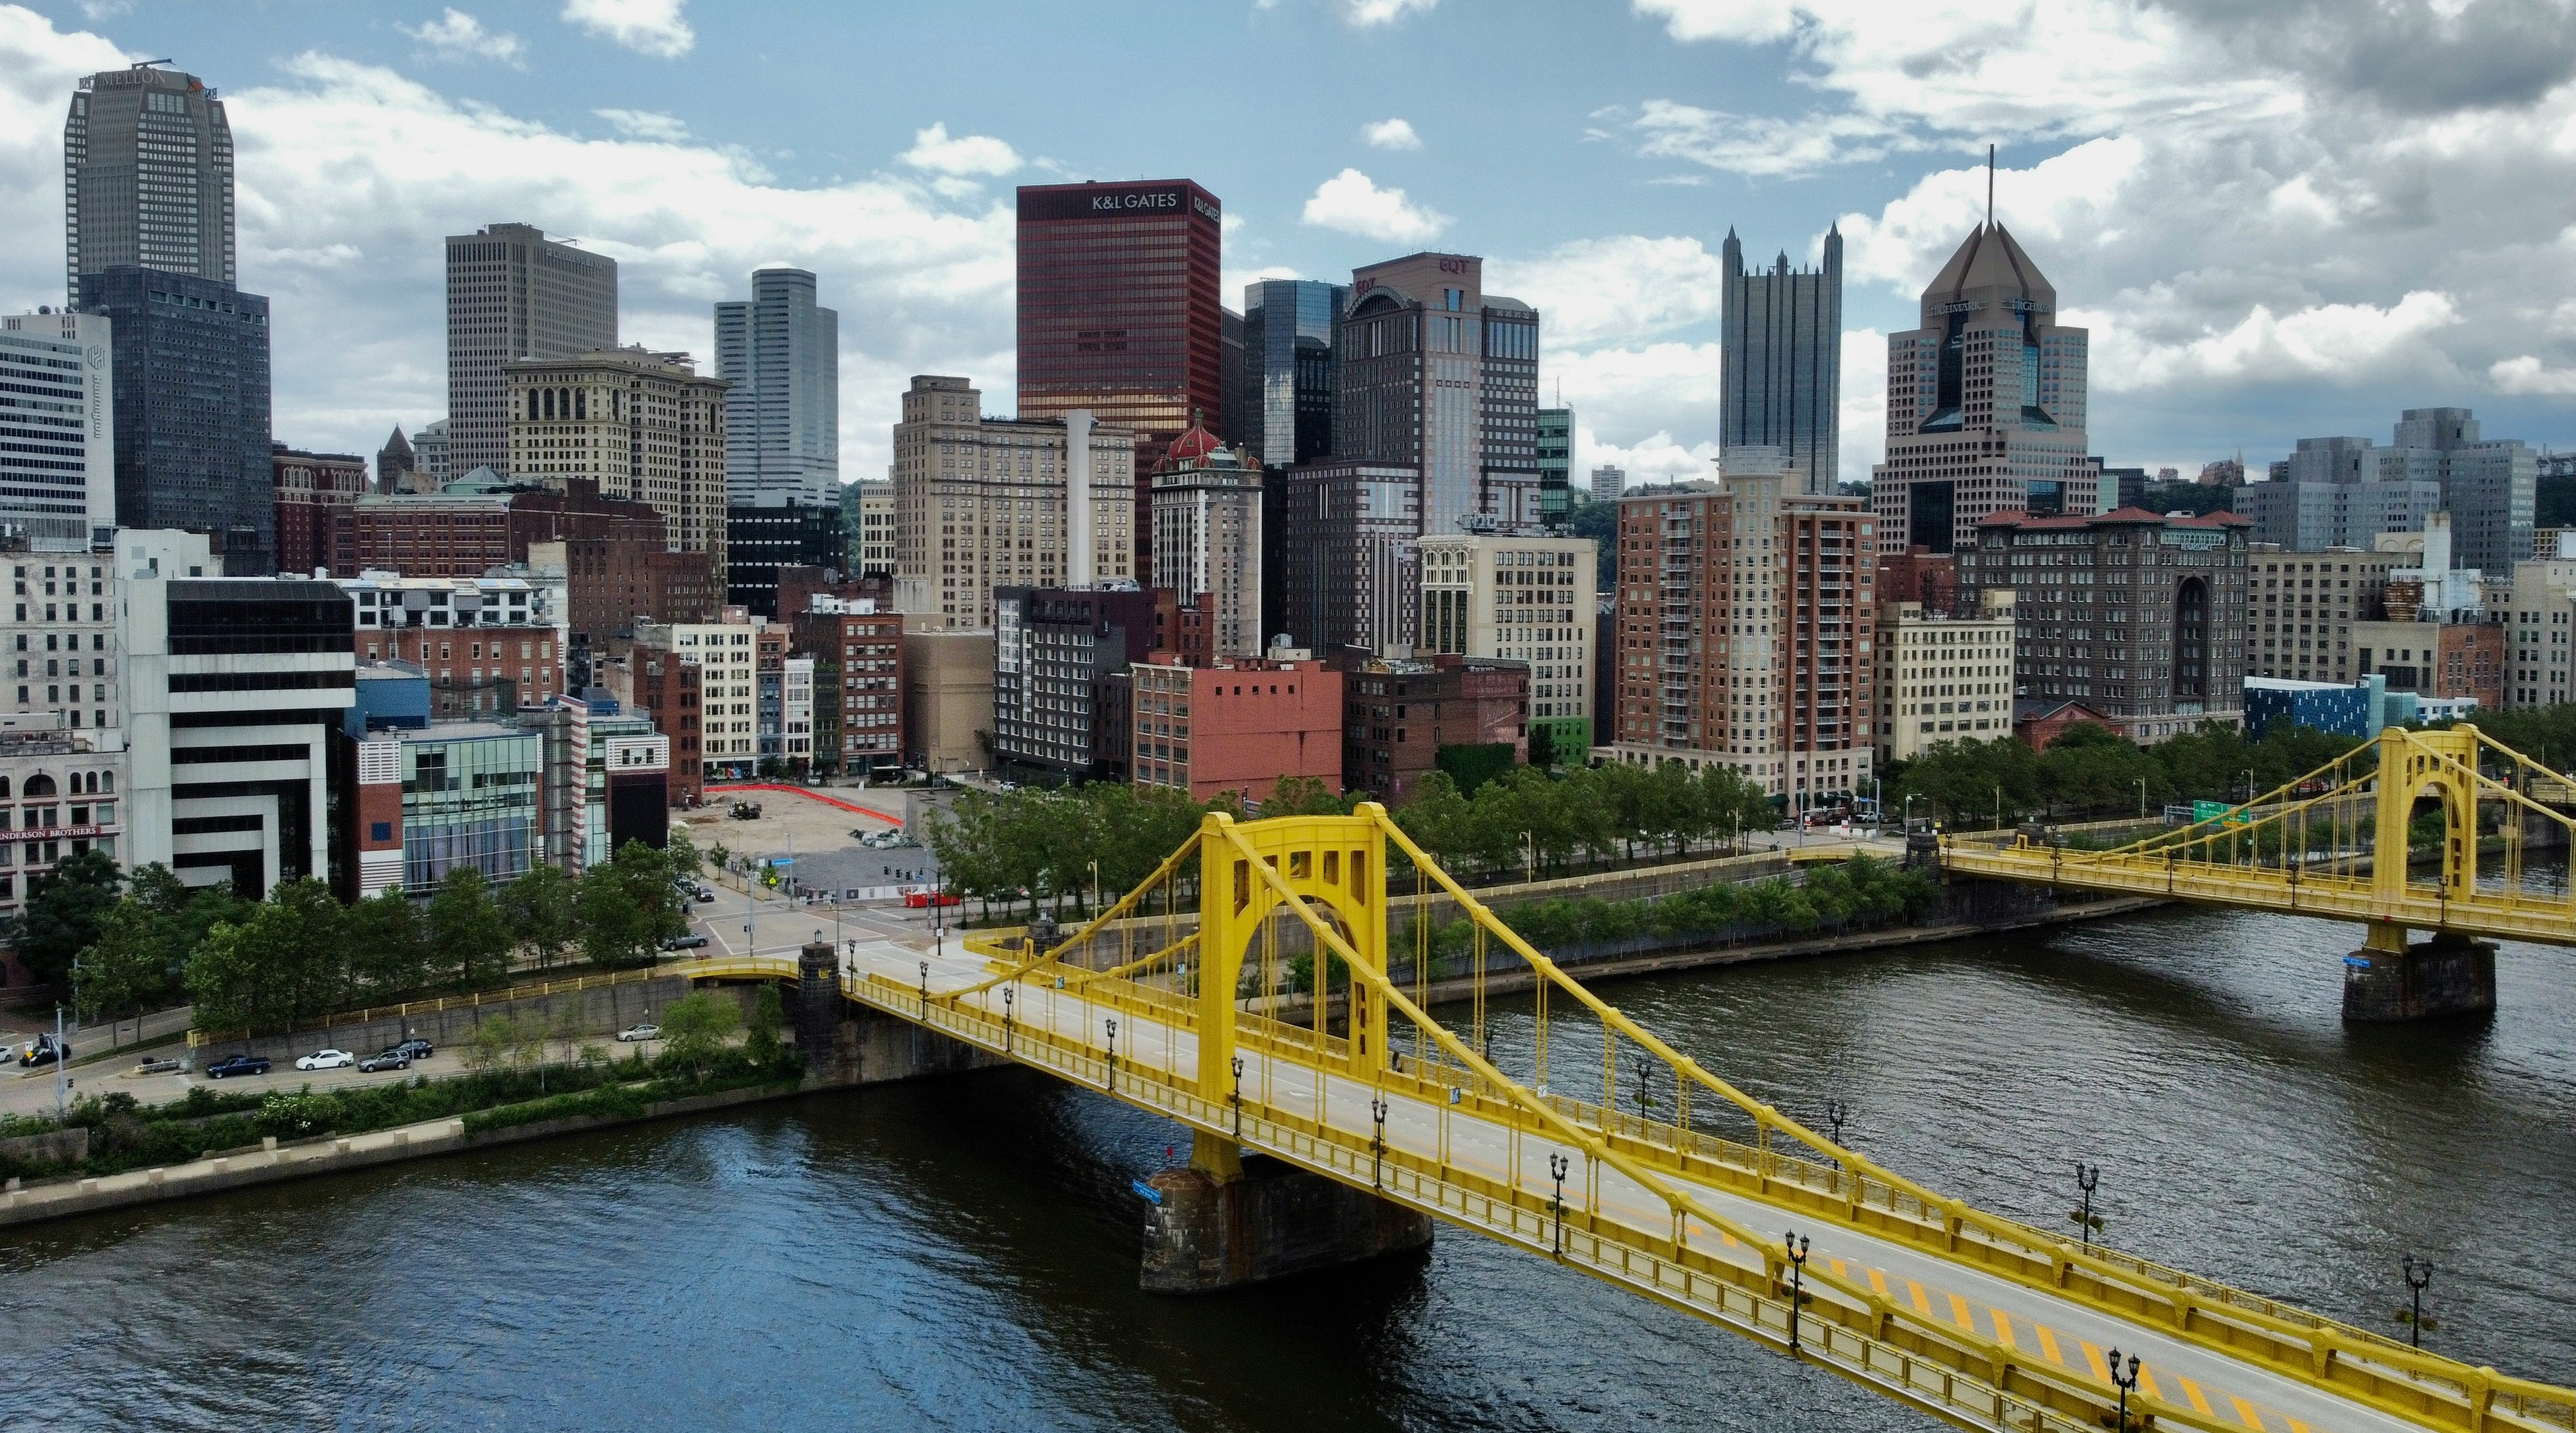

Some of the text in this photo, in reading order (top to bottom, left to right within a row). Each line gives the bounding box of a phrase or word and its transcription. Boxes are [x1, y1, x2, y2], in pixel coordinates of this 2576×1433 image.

[103, 71, 165, 86] MELLON
[1093, 193, 1177, 210] K&L GATES
[1194, 195, 1220, 224] K&L GATES
[1439, 257, 1469, 274] EQT
[50, 827, 96, 838] BROTHERS
